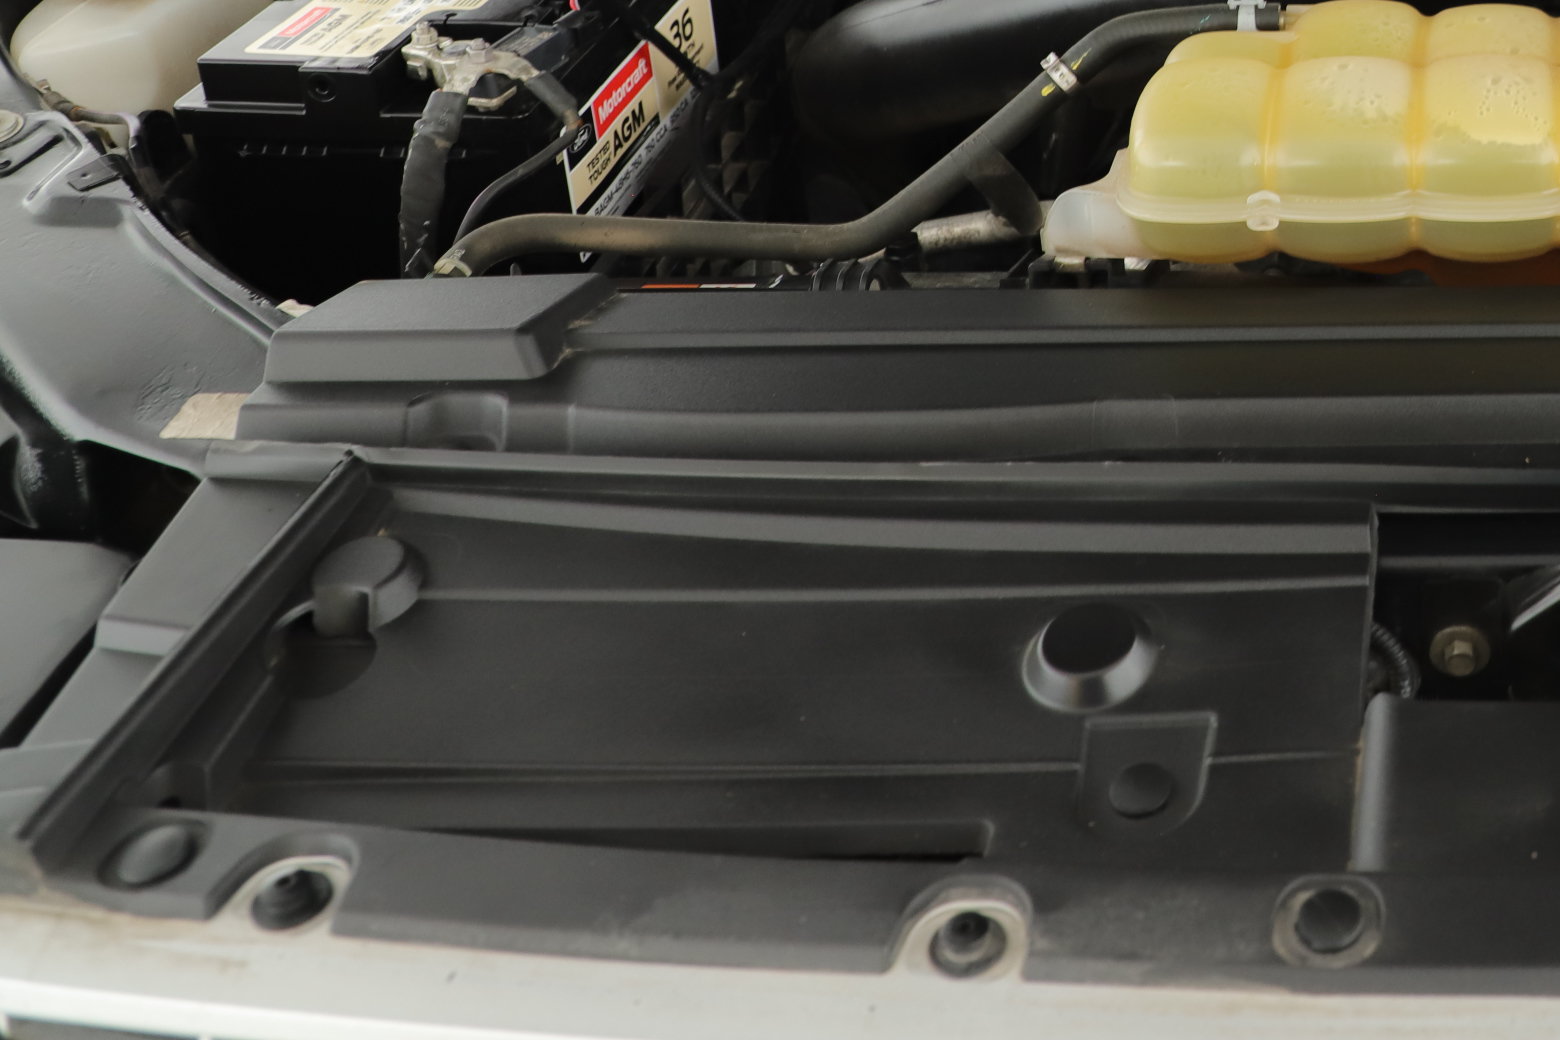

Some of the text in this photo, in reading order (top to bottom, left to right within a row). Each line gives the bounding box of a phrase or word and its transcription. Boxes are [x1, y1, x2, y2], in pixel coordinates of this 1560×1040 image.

[669, 7, 693, 49] 36
[597, 58, 649, 125] Motorcraft
[611, 101, 646, 157] AGM
[586, 141, 611, 173] TESTED
[588, 157, 612, 186] TOUGH
